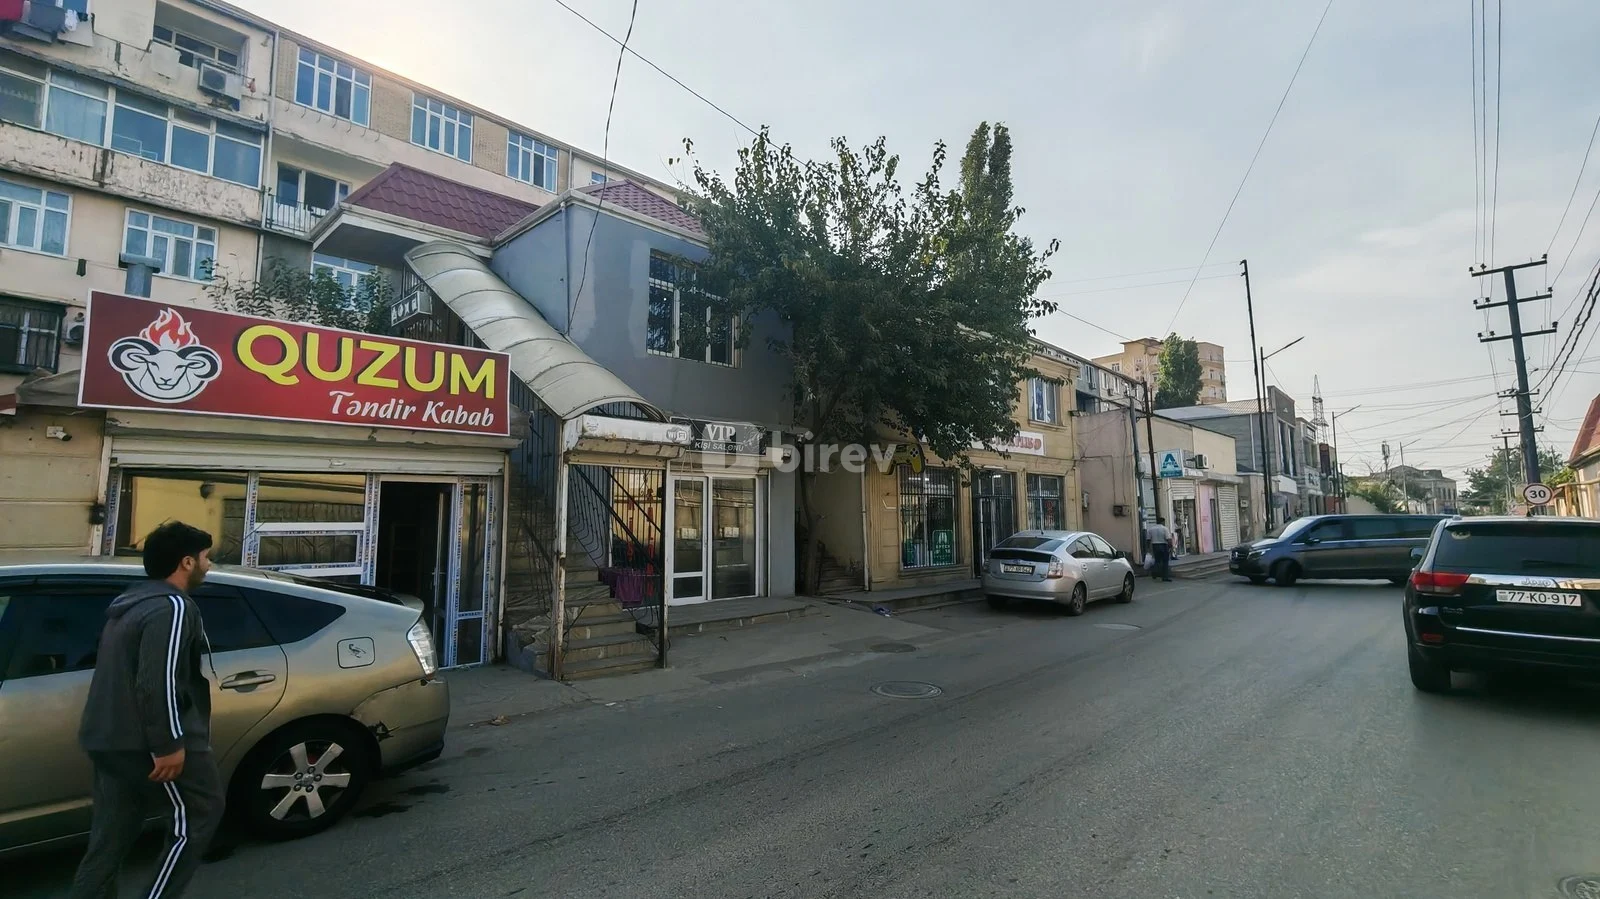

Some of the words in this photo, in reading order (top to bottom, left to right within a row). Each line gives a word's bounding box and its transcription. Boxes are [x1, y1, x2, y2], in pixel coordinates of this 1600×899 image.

[237, 324, 495, 399] QUZUM
[328, 390, 418, 421] Təndir
[421, 398, 495, 428] Kabab
[705, 423, 736, 442] VIP
[712, 443, 744, 452] SALONU
[1529, 489, 1546, 499] 30
